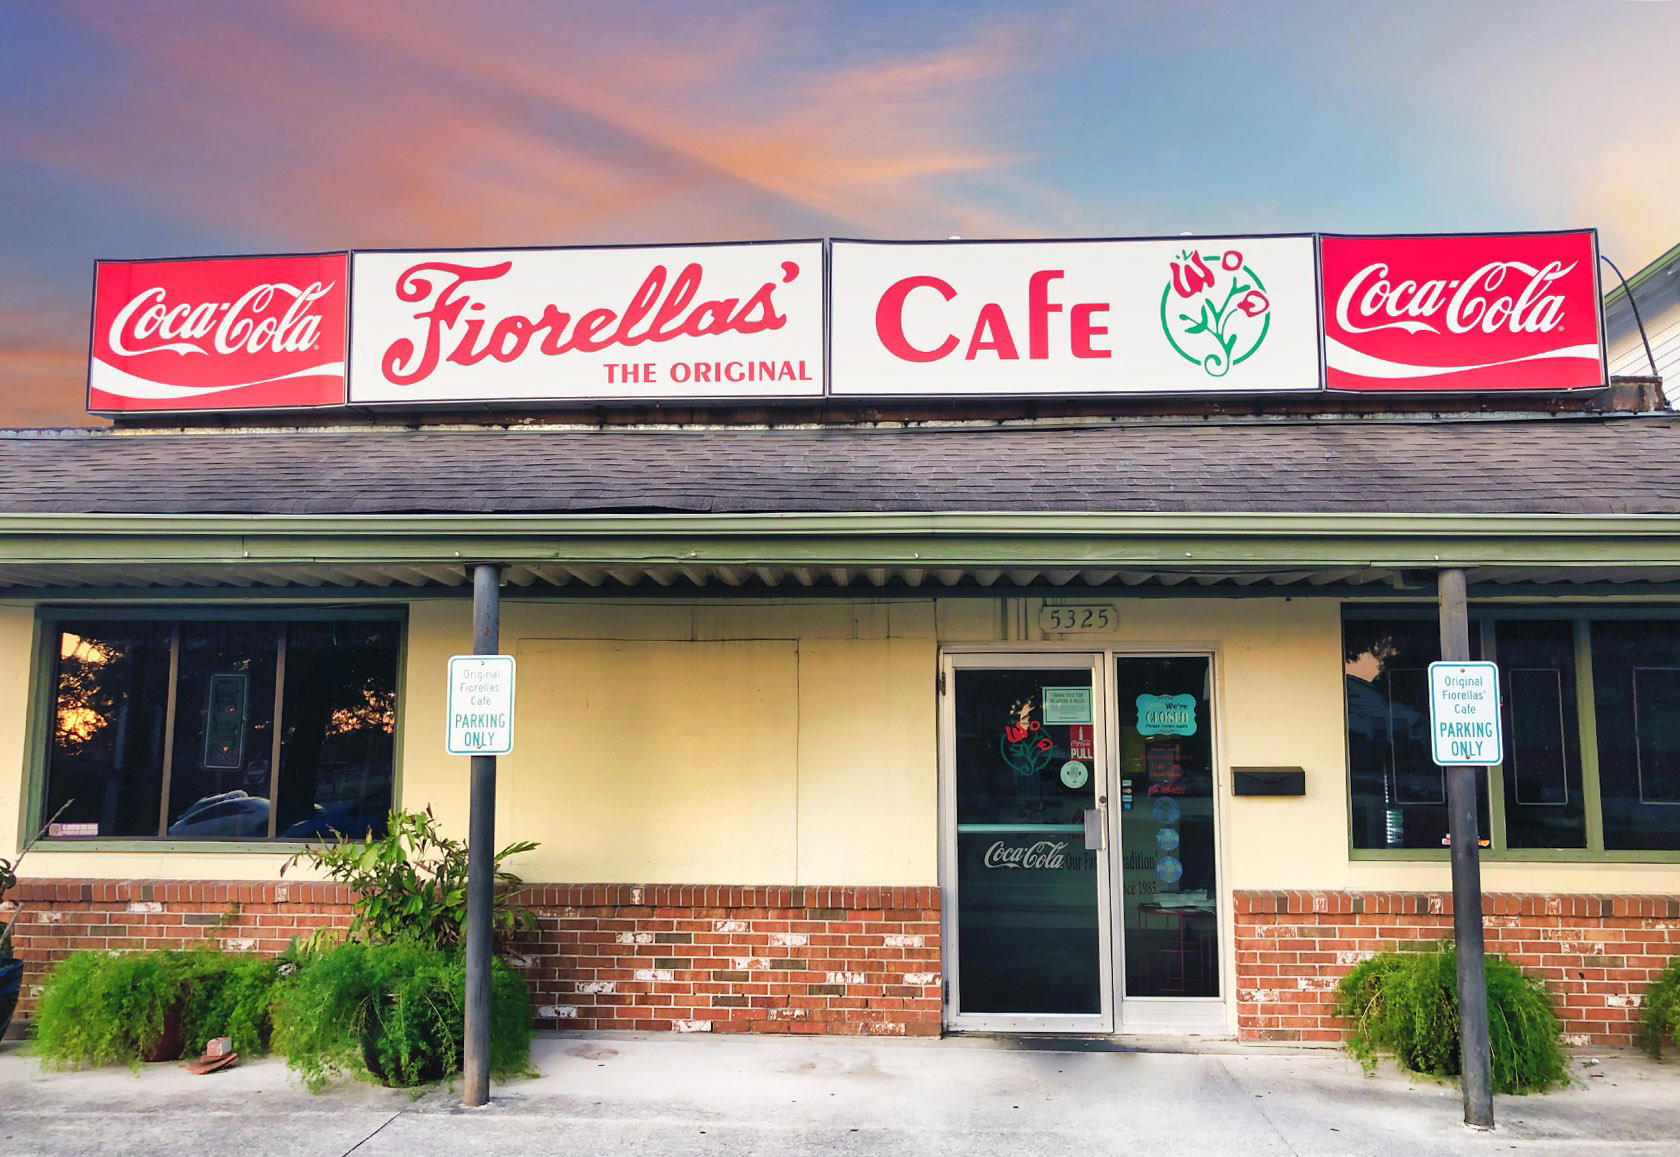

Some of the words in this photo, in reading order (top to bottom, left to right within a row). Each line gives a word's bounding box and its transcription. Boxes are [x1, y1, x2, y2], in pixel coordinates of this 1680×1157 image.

[1335, 260, 1578, 335] Coca-Cola
[108, 279, 335, 357] Coca-Cola
[382, 261, 800, 386] Fiorellas'
[604, 363, 657, 384] THE
[669, 359, 813, 383] ORIGINAL
[1050, 607, 1109, 630] 5325
[463, 669, 500, 681] Original
[1444, 676, 1483, 689] Original
[471, 696, 492, 706] Cafe
[1165, 702, 1189, 710] We're
[1454, 704, 1476, 714] Cafe
[455, 713, 506, 729] PARKING
[1145, 710, 1189, 723] CLOSED
[1439, 722, 1493, 738] PARKING
[464, 731, 496, 747] ONLY
[1070, 747, 1093, 759] PULL
[1451, 741, 1483, 757] ONLY
[984, 840, 1068, 869] Coca-Cola
[1065, 852, 1081, 871] Our
